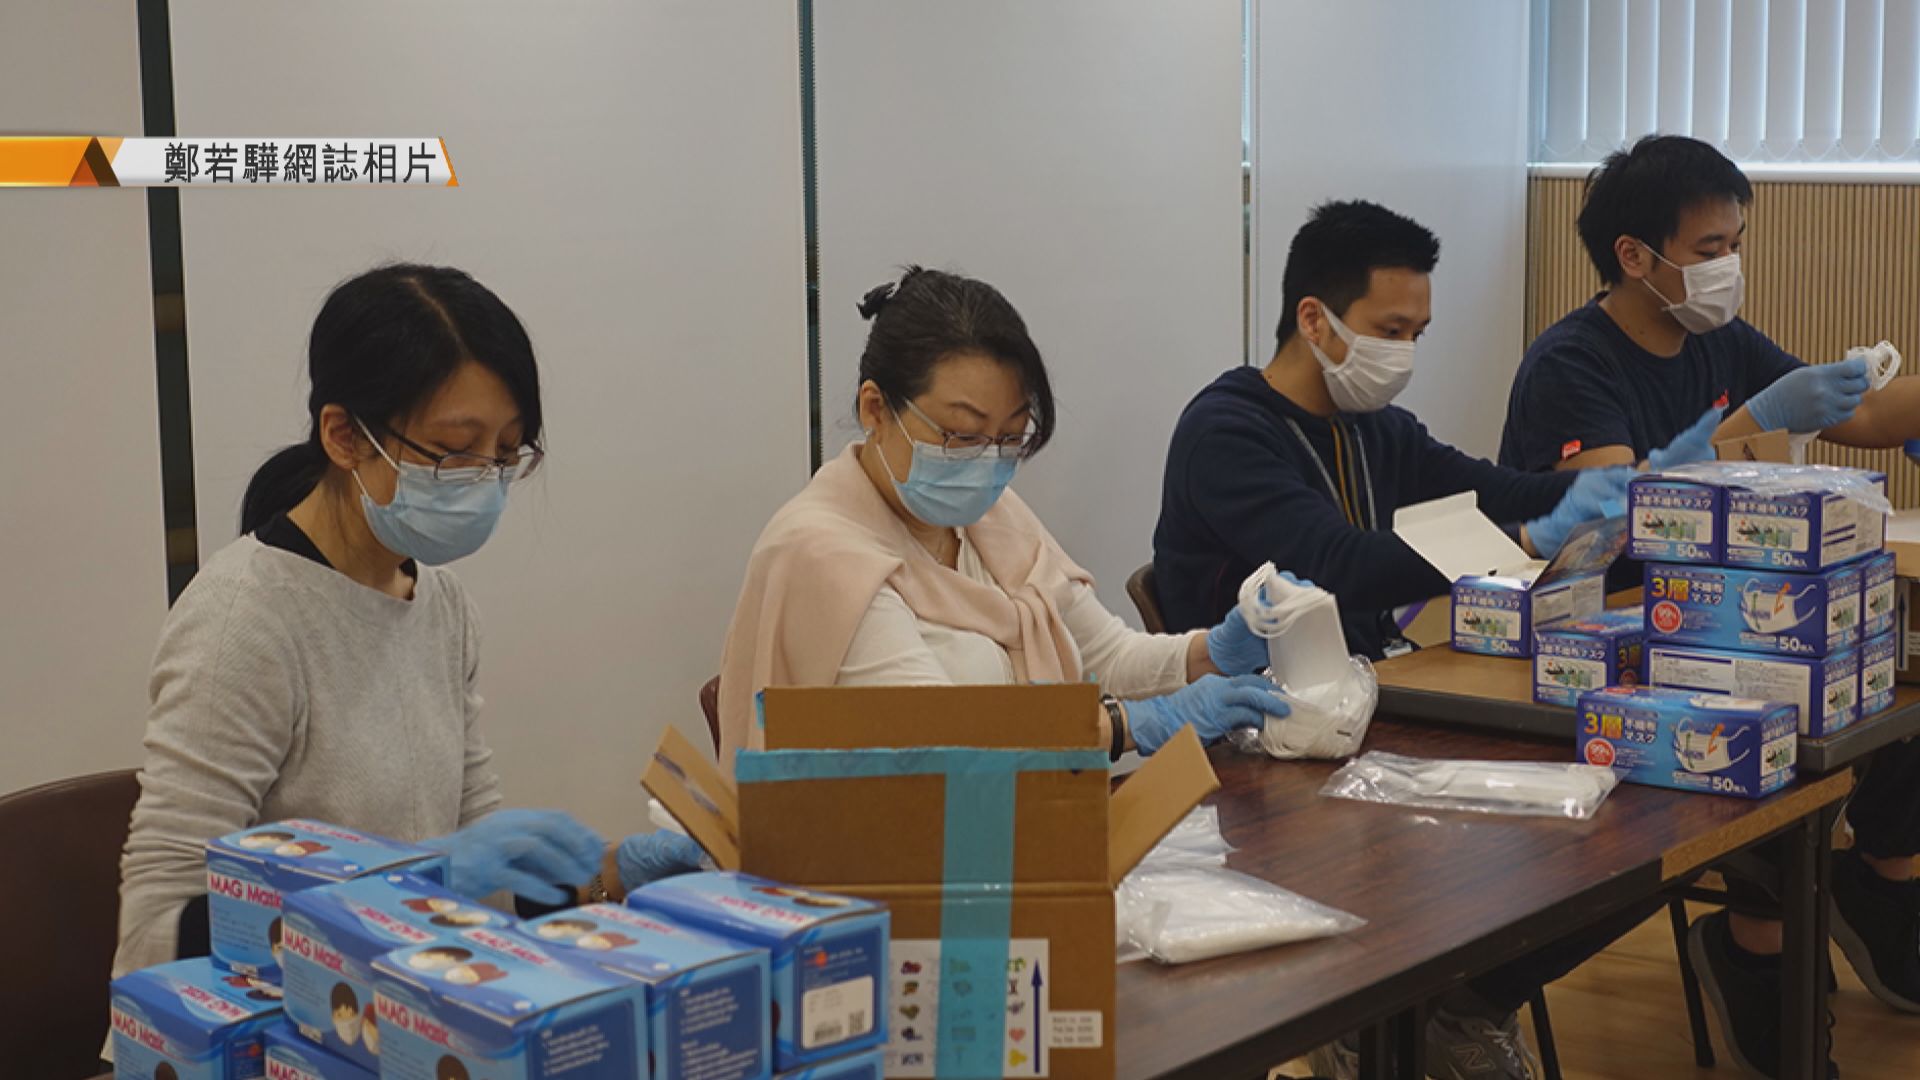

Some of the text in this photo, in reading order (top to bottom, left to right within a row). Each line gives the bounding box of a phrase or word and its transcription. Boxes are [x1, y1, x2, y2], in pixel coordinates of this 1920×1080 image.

[210, 873, 283, 908] MAG Mask
[284, 927, 311, 957] MAG
[313, 944, 344, 972] Mask
[113, 1009, 166, 1053] MAG Mask
[376, 995, 450, 1047] MAG Mask
